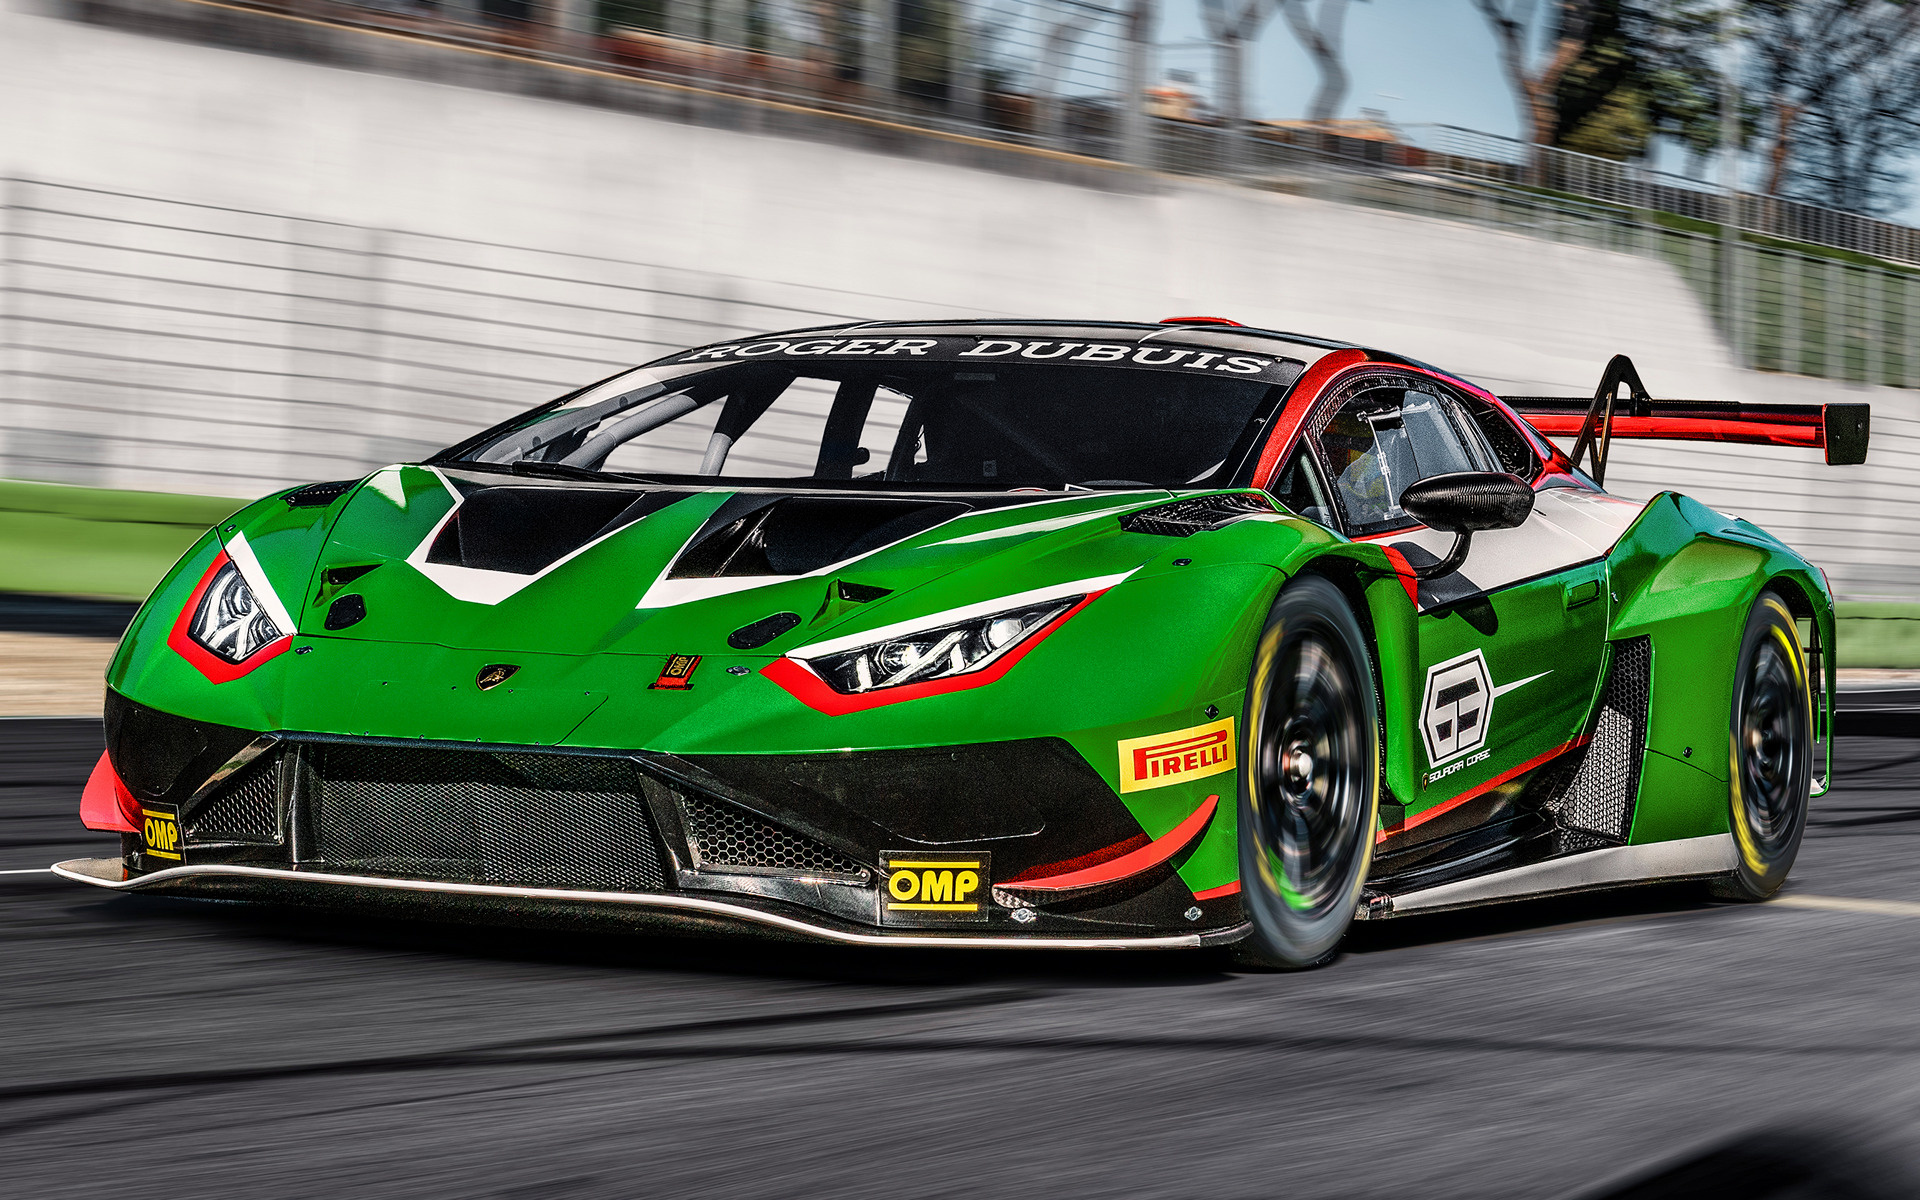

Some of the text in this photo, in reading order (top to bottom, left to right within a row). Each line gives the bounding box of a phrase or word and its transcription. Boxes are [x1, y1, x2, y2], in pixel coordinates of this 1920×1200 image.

[678, 339, 1272, 374] ROGER DUBUIS
[1133, 729, 1228, 781] PIRELLI
[1429, 748, 1491, 783] SQUADRA CORSE
[144, 817, 178, 851] OMP
[888, 869, 979, 902] OMP
